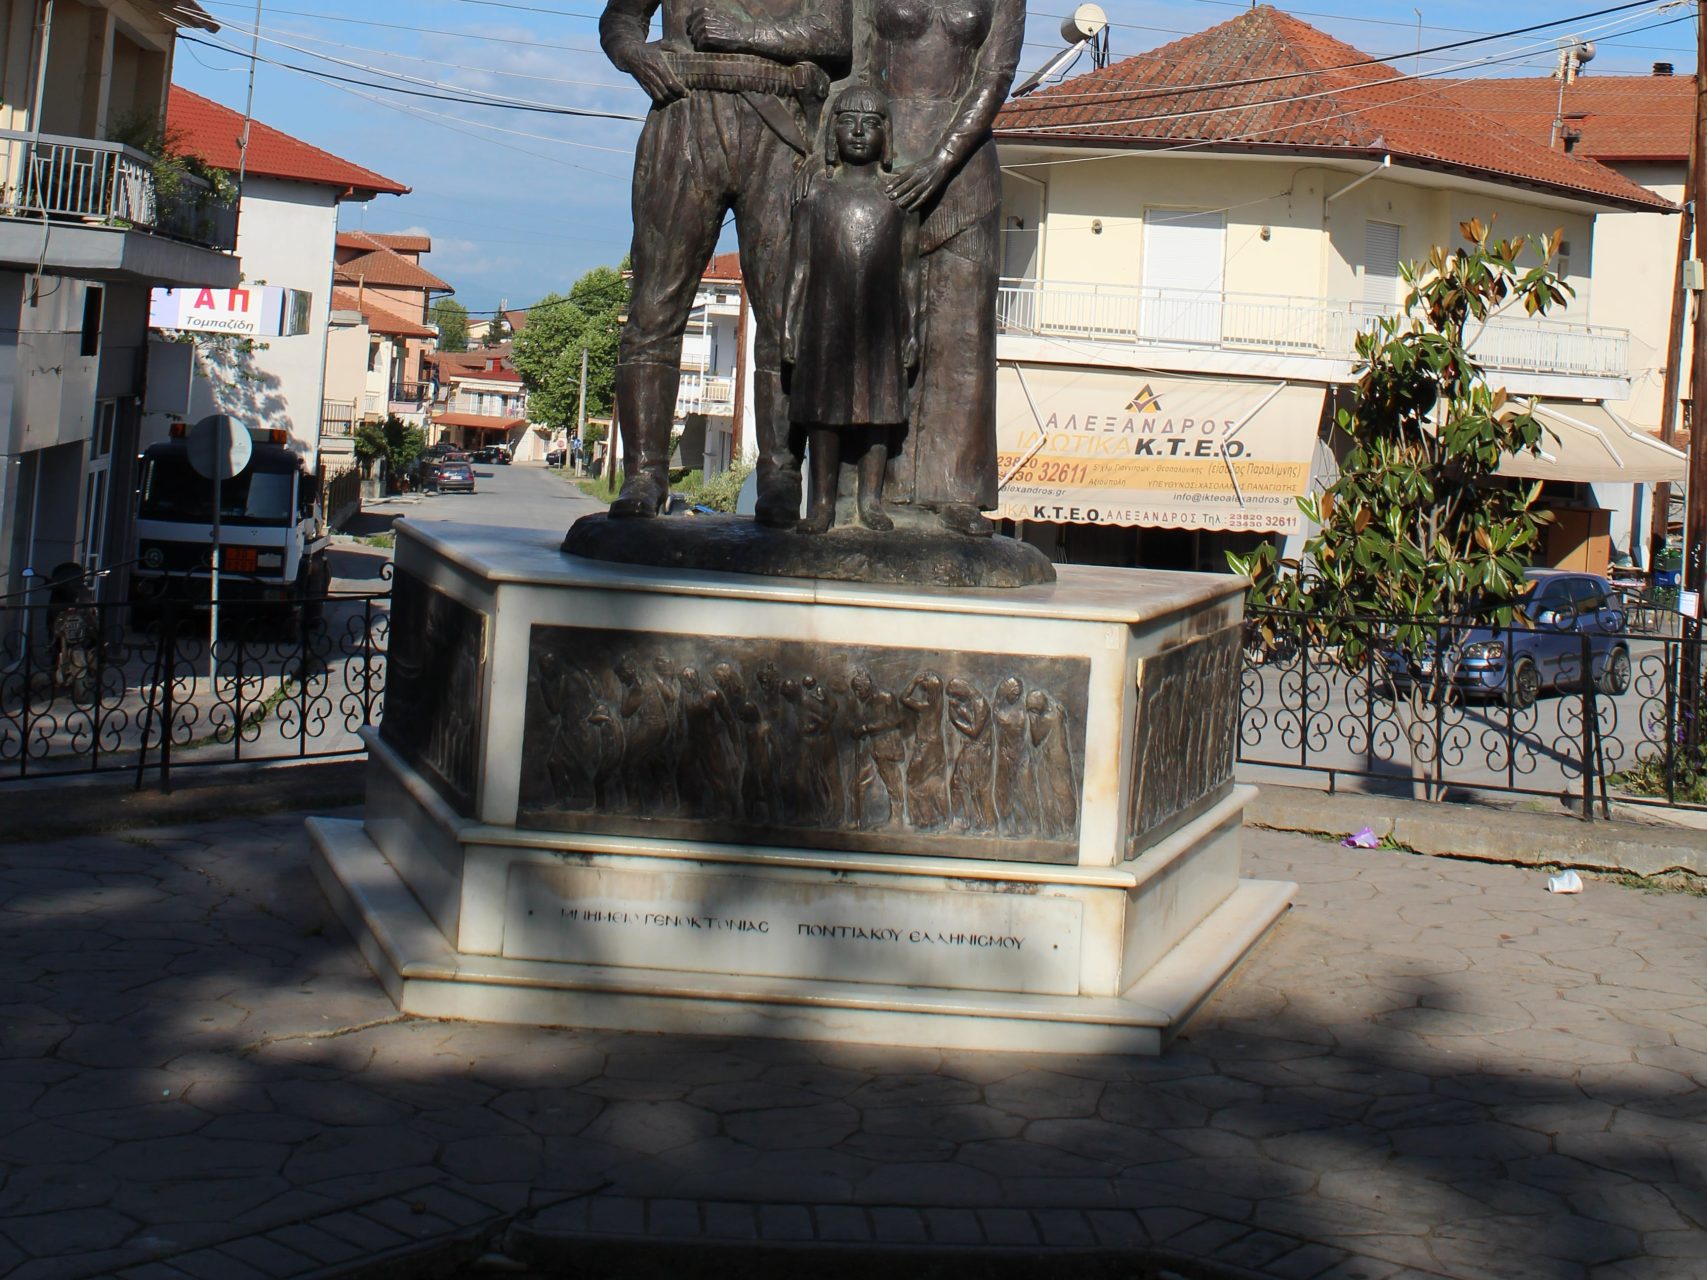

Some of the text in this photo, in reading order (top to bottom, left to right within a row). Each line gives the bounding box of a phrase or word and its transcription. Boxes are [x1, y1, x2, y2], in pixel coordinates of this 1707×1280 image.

[186, 316, 254, 332] Τομπαζίδη
[1046, 412, 1235, 436] ΑΛΕΞΑΝΔΡΟΣ
[1016, 431, 1131, 455] ΙΔΩΤΙΚΑ
[998, 456, 1038, 469] 2380
[1038, 461, 1088, 484] 32611
[1000, 484, 1067, 497] alexandros.gr
[1106, 510, 1197, 523] ΑΛΕΞΑΝΔΡΟΣ
[1229, 513, 1263, 521] 23820
[1265, 516, 1297, 527] 32611
[1229, 520, 1263, 528] 23430
[798, 923, 904, 943] ΠΟΝΤΙΑΚΟΥ
